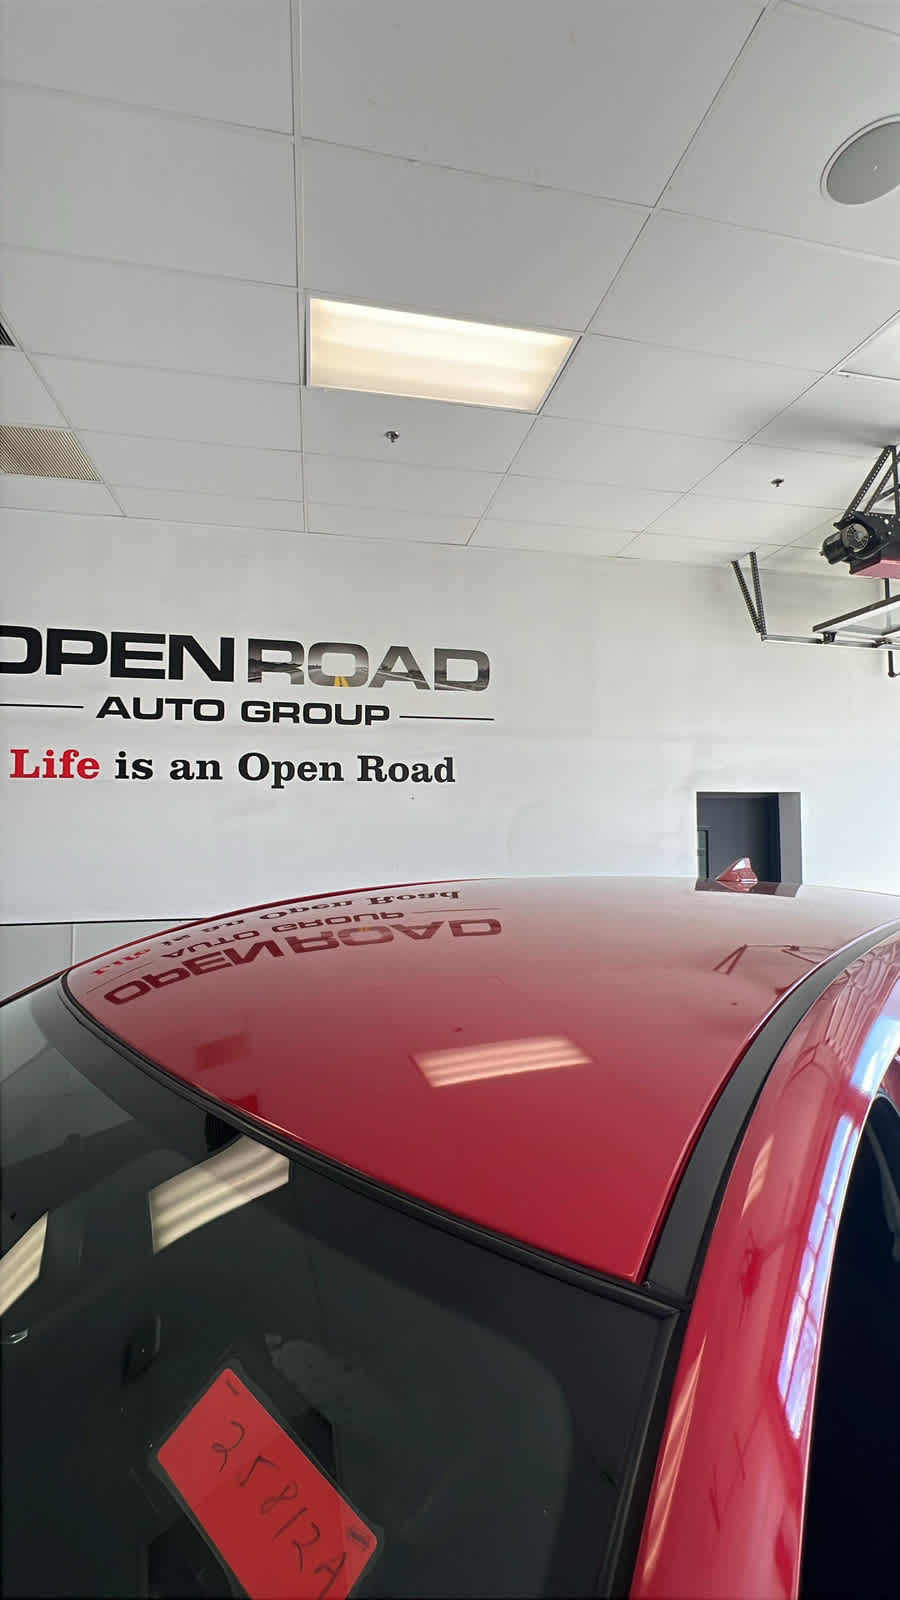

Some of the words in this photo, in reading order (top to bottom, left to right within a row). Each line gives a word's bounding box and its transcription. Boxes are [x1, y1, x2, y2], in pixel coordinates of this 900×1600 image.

[0, 625, 235, 683] OPEN
[247, 638, 491, 691] ROAD
[96, 696, 225, 722] AUTO
[240, 700, 390, 726] GROUP
[9, 748, 101, 780] Life
[114, 750, 154, 781] is
[168, 758, 224, 781] an
[237, 751, 345, 789] Open
[356, 754, 456, 784] Road
